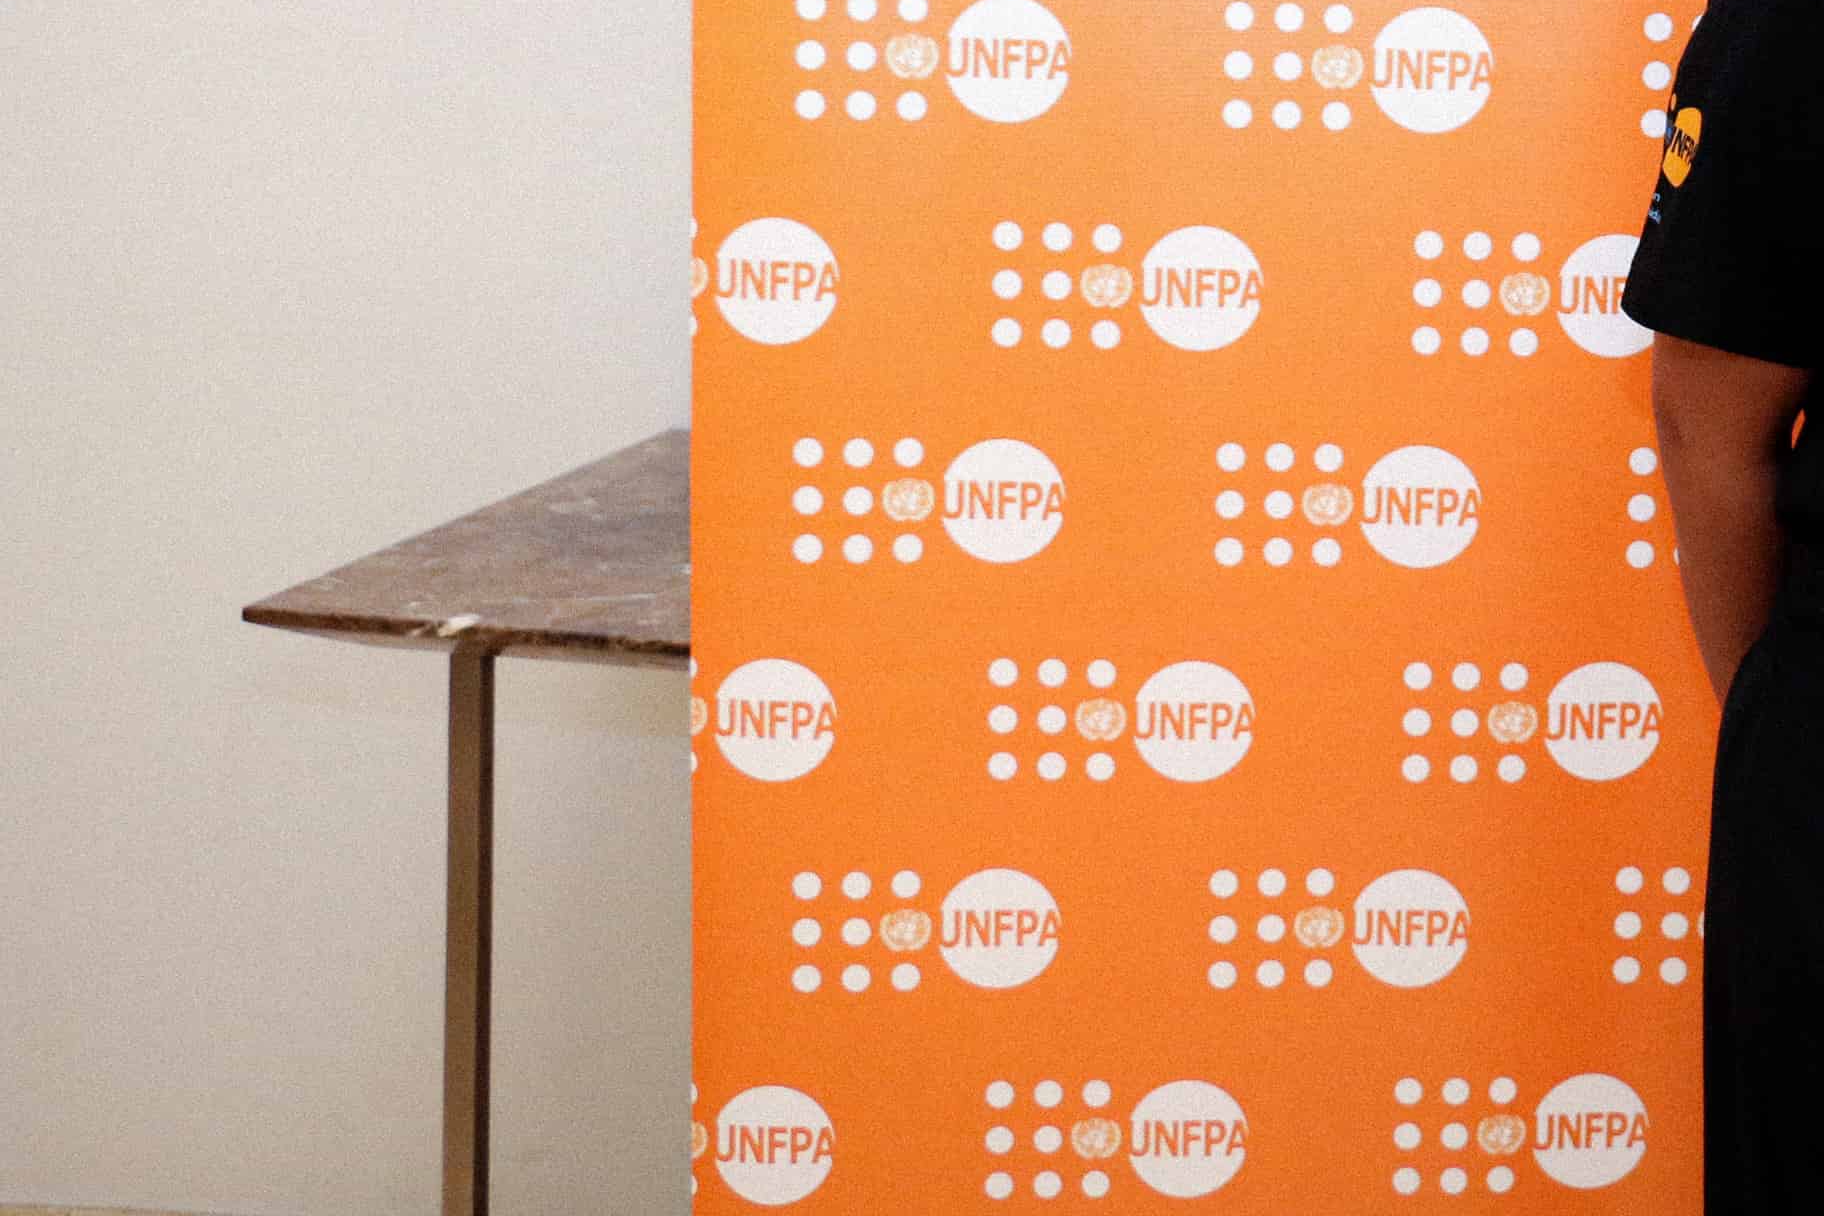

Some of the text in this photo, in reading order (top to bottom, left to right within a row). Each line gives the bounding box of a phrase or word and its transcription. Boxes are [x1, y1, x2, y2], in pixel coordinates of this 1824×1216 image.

[946, 37, 1069, 80] UNFPA
[1371, 50, 1492, 91] UNFPA
[715, 258, 839, 301] UNFPA
[1140, 267, 1263, 308] UNFPA
[1557, 275, 1628, 315] UNF
[941, 480, 1065, 521] UNFPA
[1359, 487, 1480, 527] UNFPA
[715, 700, 838, 738] UNFPA
[1133, 701, 1255, 740] UNFPA
[1544, 702, 1662, 740] UNFPA
[939, 910, 1061, 948] UNFPA
[1351, 910, 1469, 947] UNFPA
[714, 1125, 836, 1164] UNFPA
[1128, 1120, 1249, 1158] UNFPA
[1531, 1113, 1650, 1151] UNFPA
